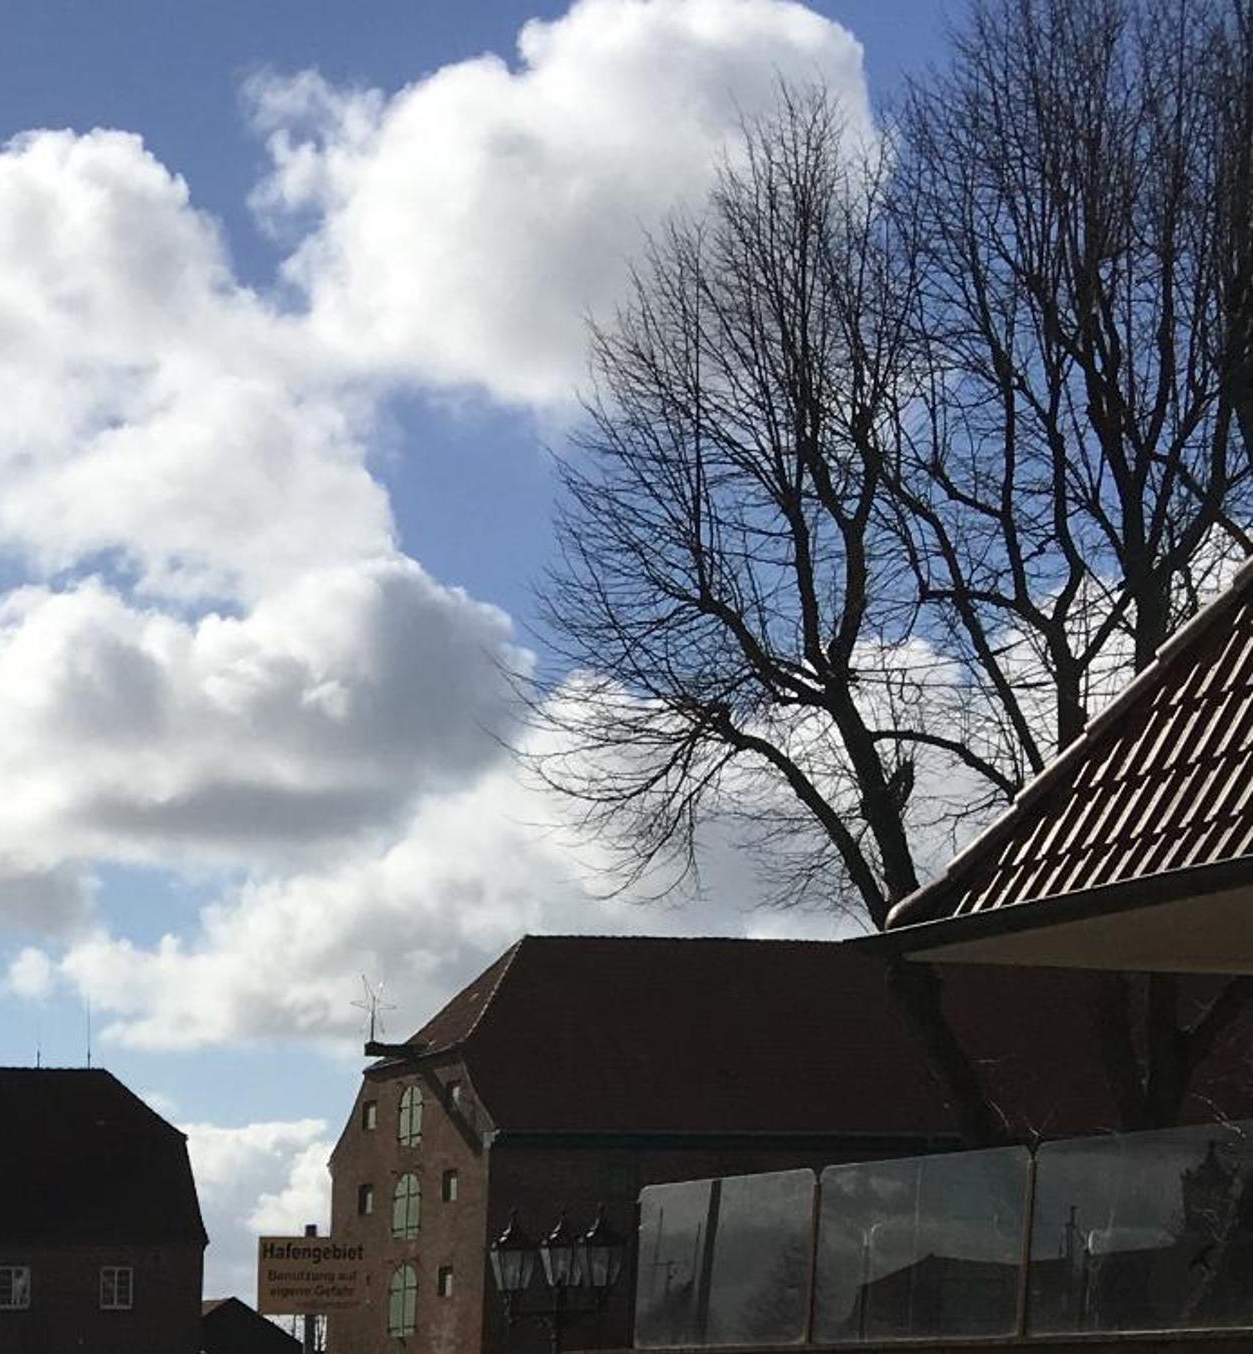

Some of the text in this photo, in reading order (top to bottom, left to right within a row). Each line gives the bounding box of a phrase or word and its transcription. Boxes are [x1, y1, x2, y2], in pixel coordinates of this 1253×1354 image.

[263, 1242, 365, 1264] Hafengebiet
[267, 1270, 357, 1284] Benutzung auf
[270, 1285, 356, 1298] eigene Gefahr
